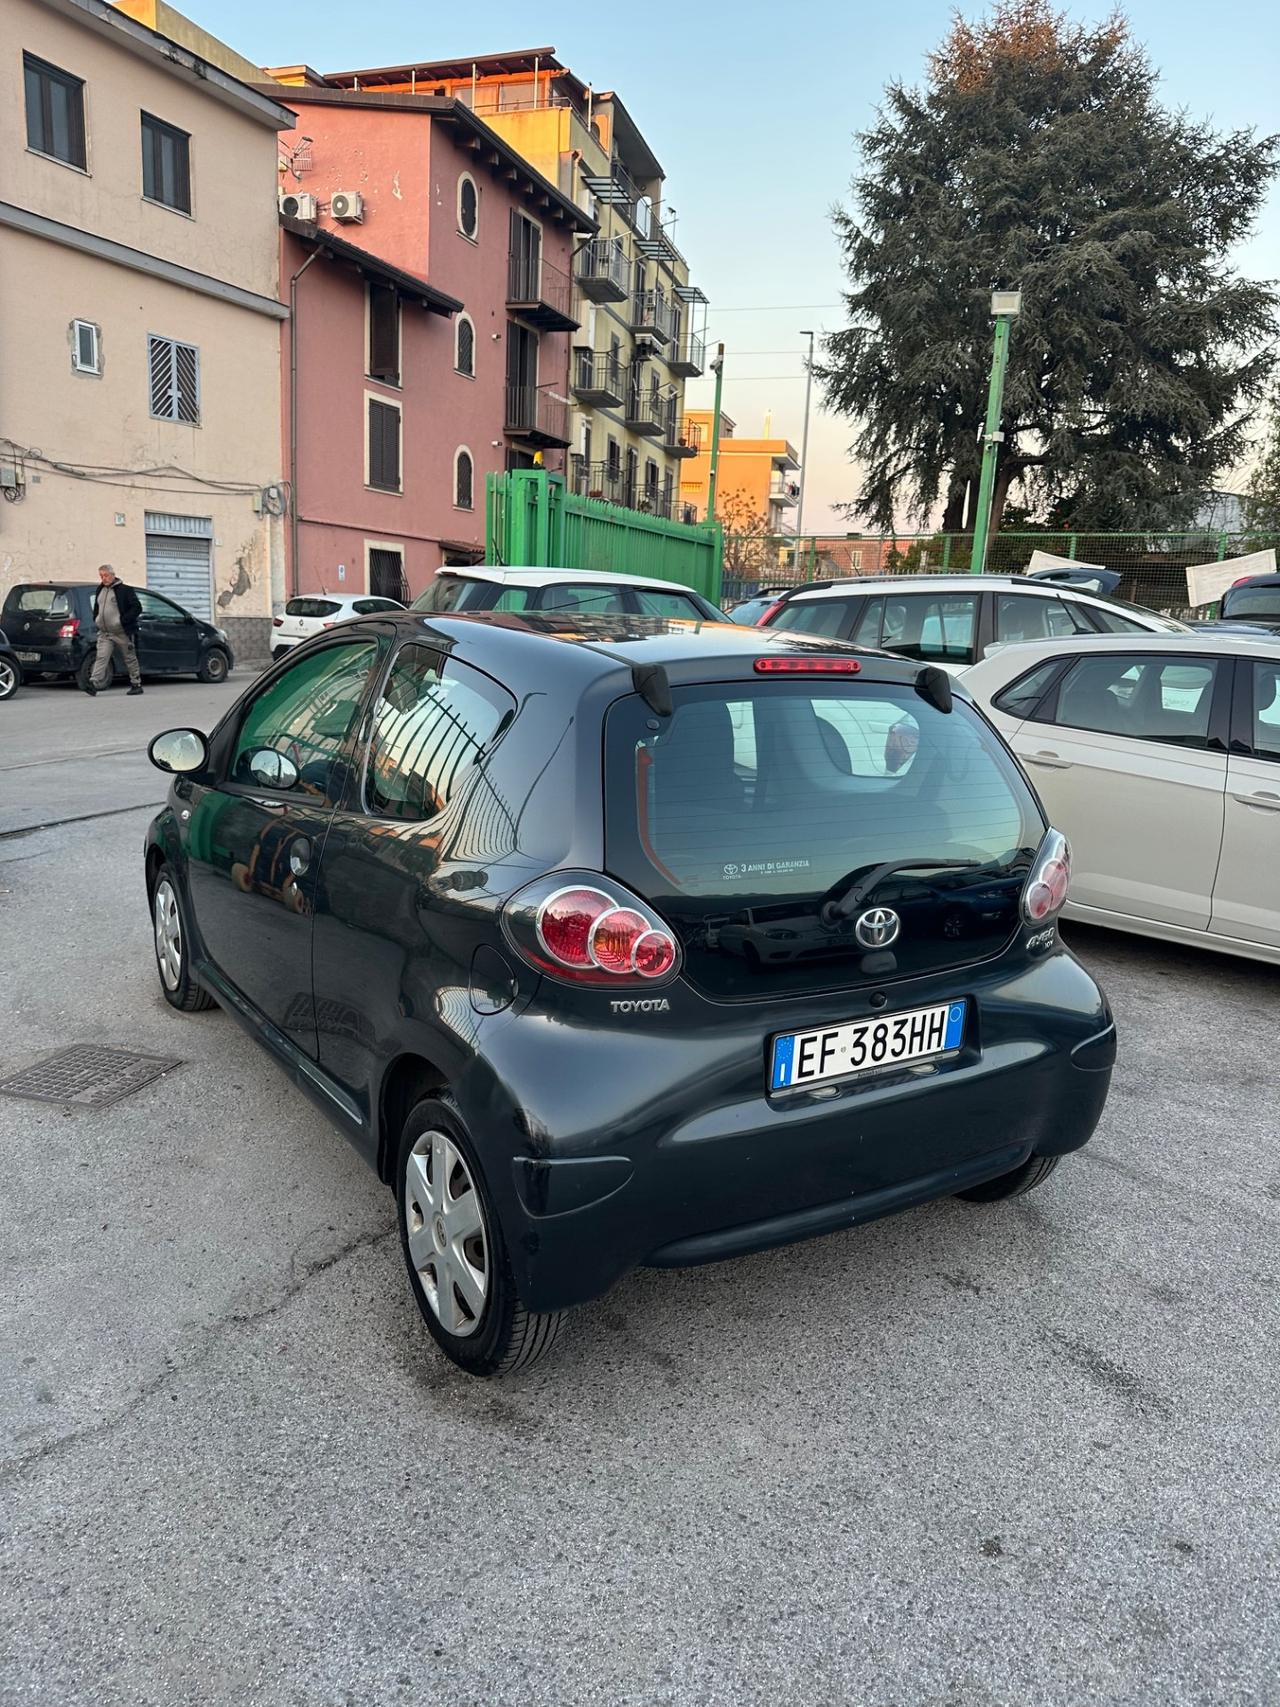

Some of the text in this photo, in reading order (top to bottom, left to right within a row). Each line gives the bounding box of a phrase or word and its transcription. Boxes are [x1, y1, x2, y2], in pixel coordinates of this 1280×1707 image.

[741, 863, 747, 873] 3
[748, 863, 766, 872] ANNI
[767, 862, 775, 870] DI
[776, 860, 810, 869] GARANZIA
[610, 999, 670, 1013] TOYOTA
[797, 1010, 946, 1079] EF 383HH
